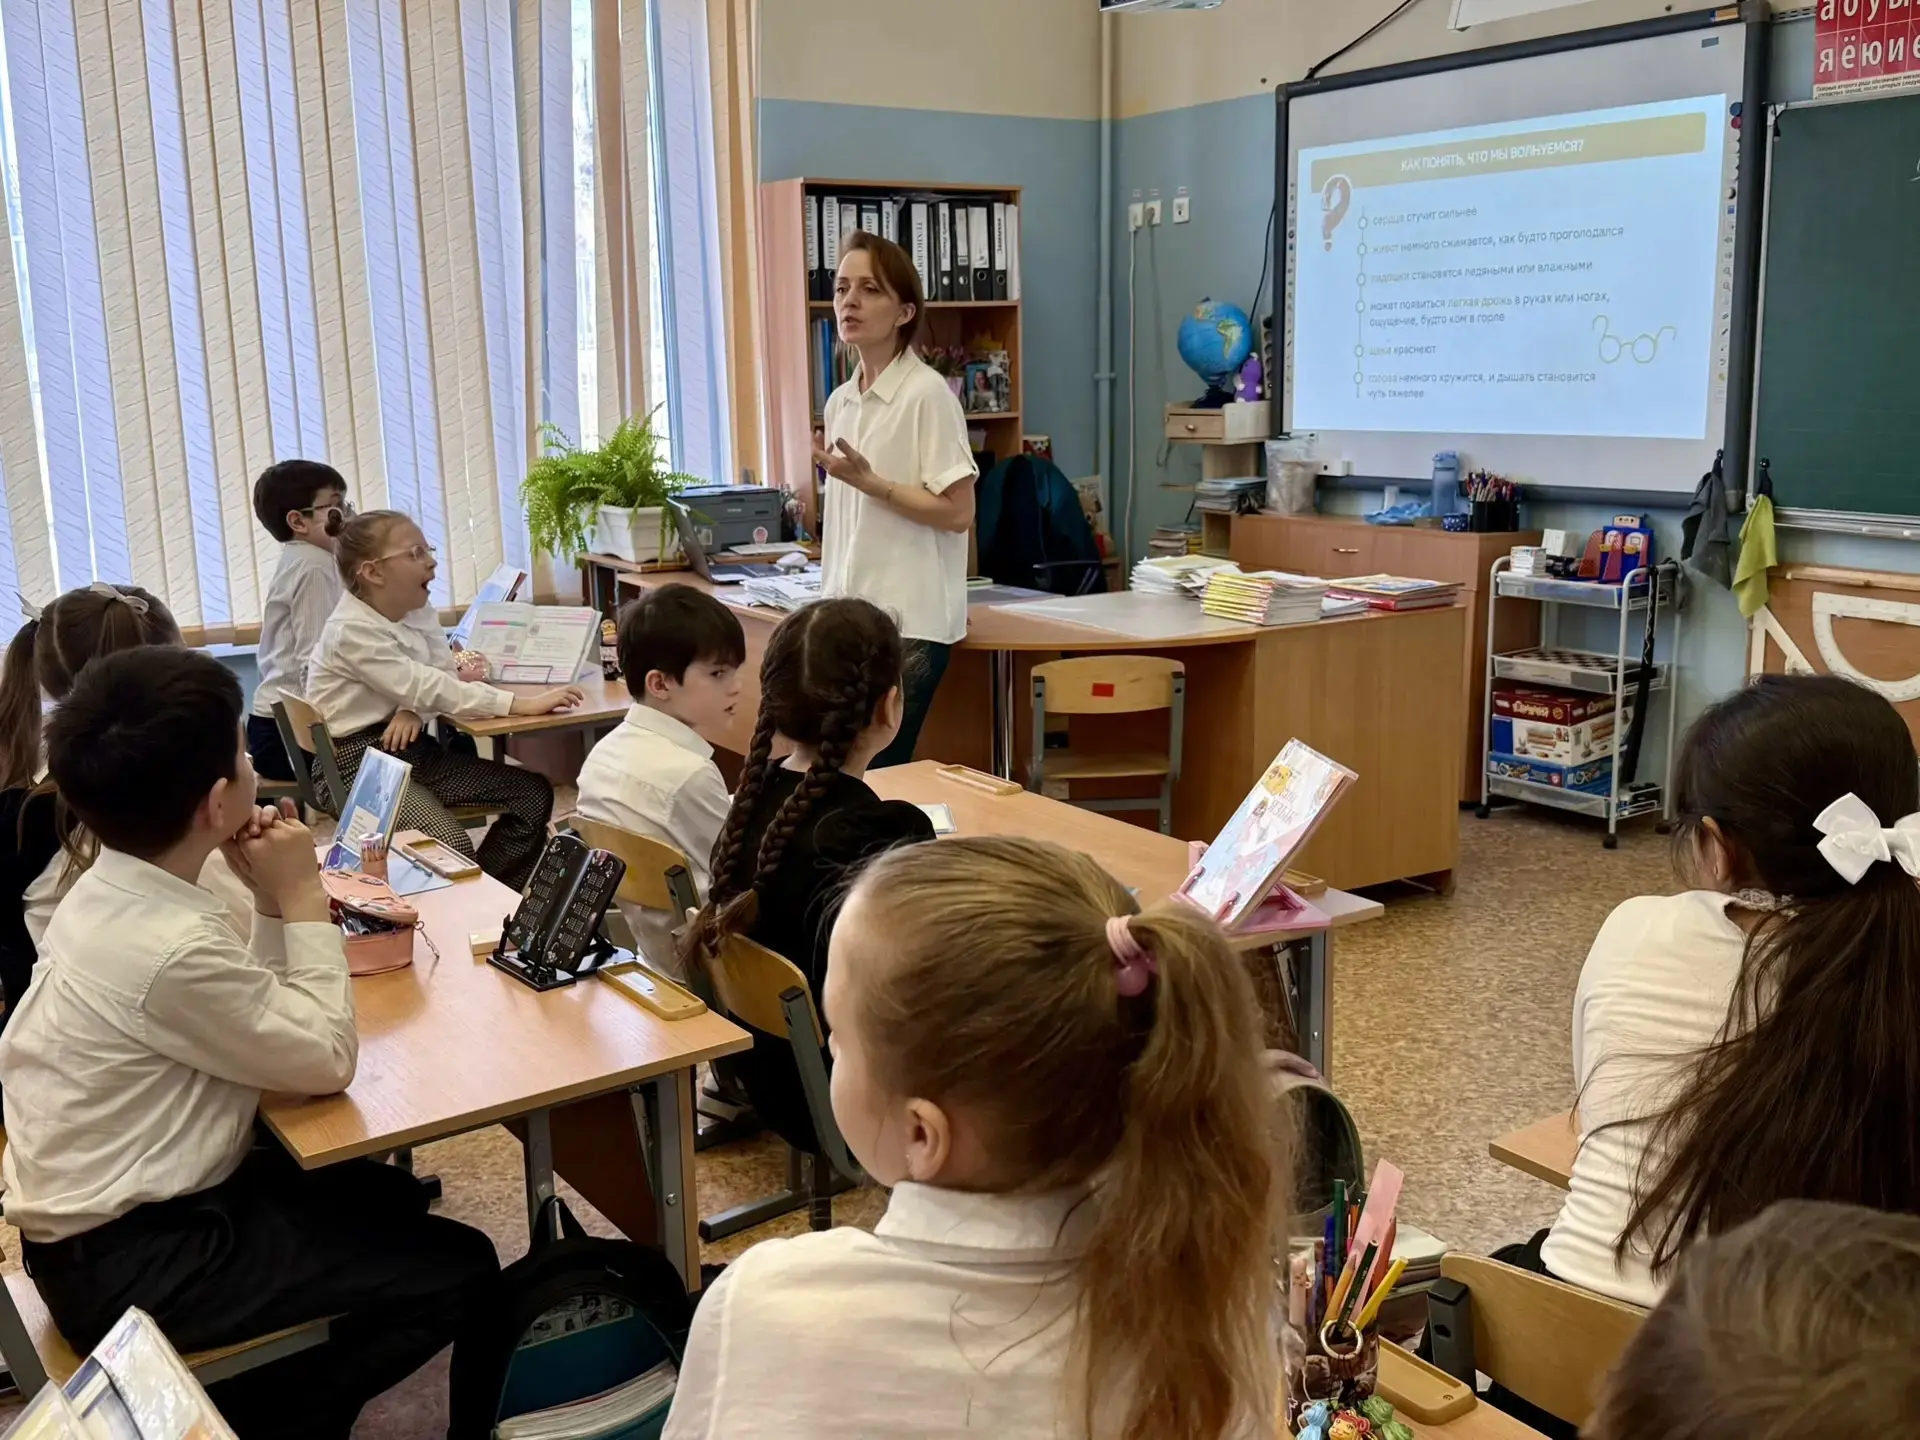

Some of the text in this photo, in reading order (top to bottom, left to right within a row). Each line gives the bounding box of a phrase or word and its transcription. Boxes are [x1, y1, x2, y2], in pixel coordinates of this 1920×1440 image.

[1401, 139, 1585, 171] КАК ПОНЯТЬ, ЧТО МЫ ВОЛНУЕМСЯ?
[1406, 211, 1437, 222] стучит
[1437, 206, 1478, 219] сильнее
[1400, 240, 1440, 252] немного
[1441, 236, 1496, 248] сжимается,
[1498, 234, 1515, 244] как
[1517, 230, 1547, 245] будто
[1549, 226, 1624, 242] проголодался
[1411, 268, 1463, 280] становятся
[1464, 264, 1514, 277] ледяными
[1516, 263, 1535, 274] или
[1537, 260, 1593, 273] влажными
[1370, 301, 1399, 311] может
[1400, 299, 1446, 310] появиться
[1515, 295, 1521, 305] в
[1523, 294, 1553, 307] руках
[1554, 293, 1574, 303] или
[1576, 291, 1611, 303] ногах,
[1369, 313, 1506, 328] ощущение, будто ком в горле
[1393, 345, 1437, 356] краснеют
[1399, 373, 1437, 383] немного
[1439, 373, 1486, 385] кружится,
[1488, 373, 1495, 382] и
[1496, 372, 1536, 383] дышать
[1537, 372, 1596, 383] становится
